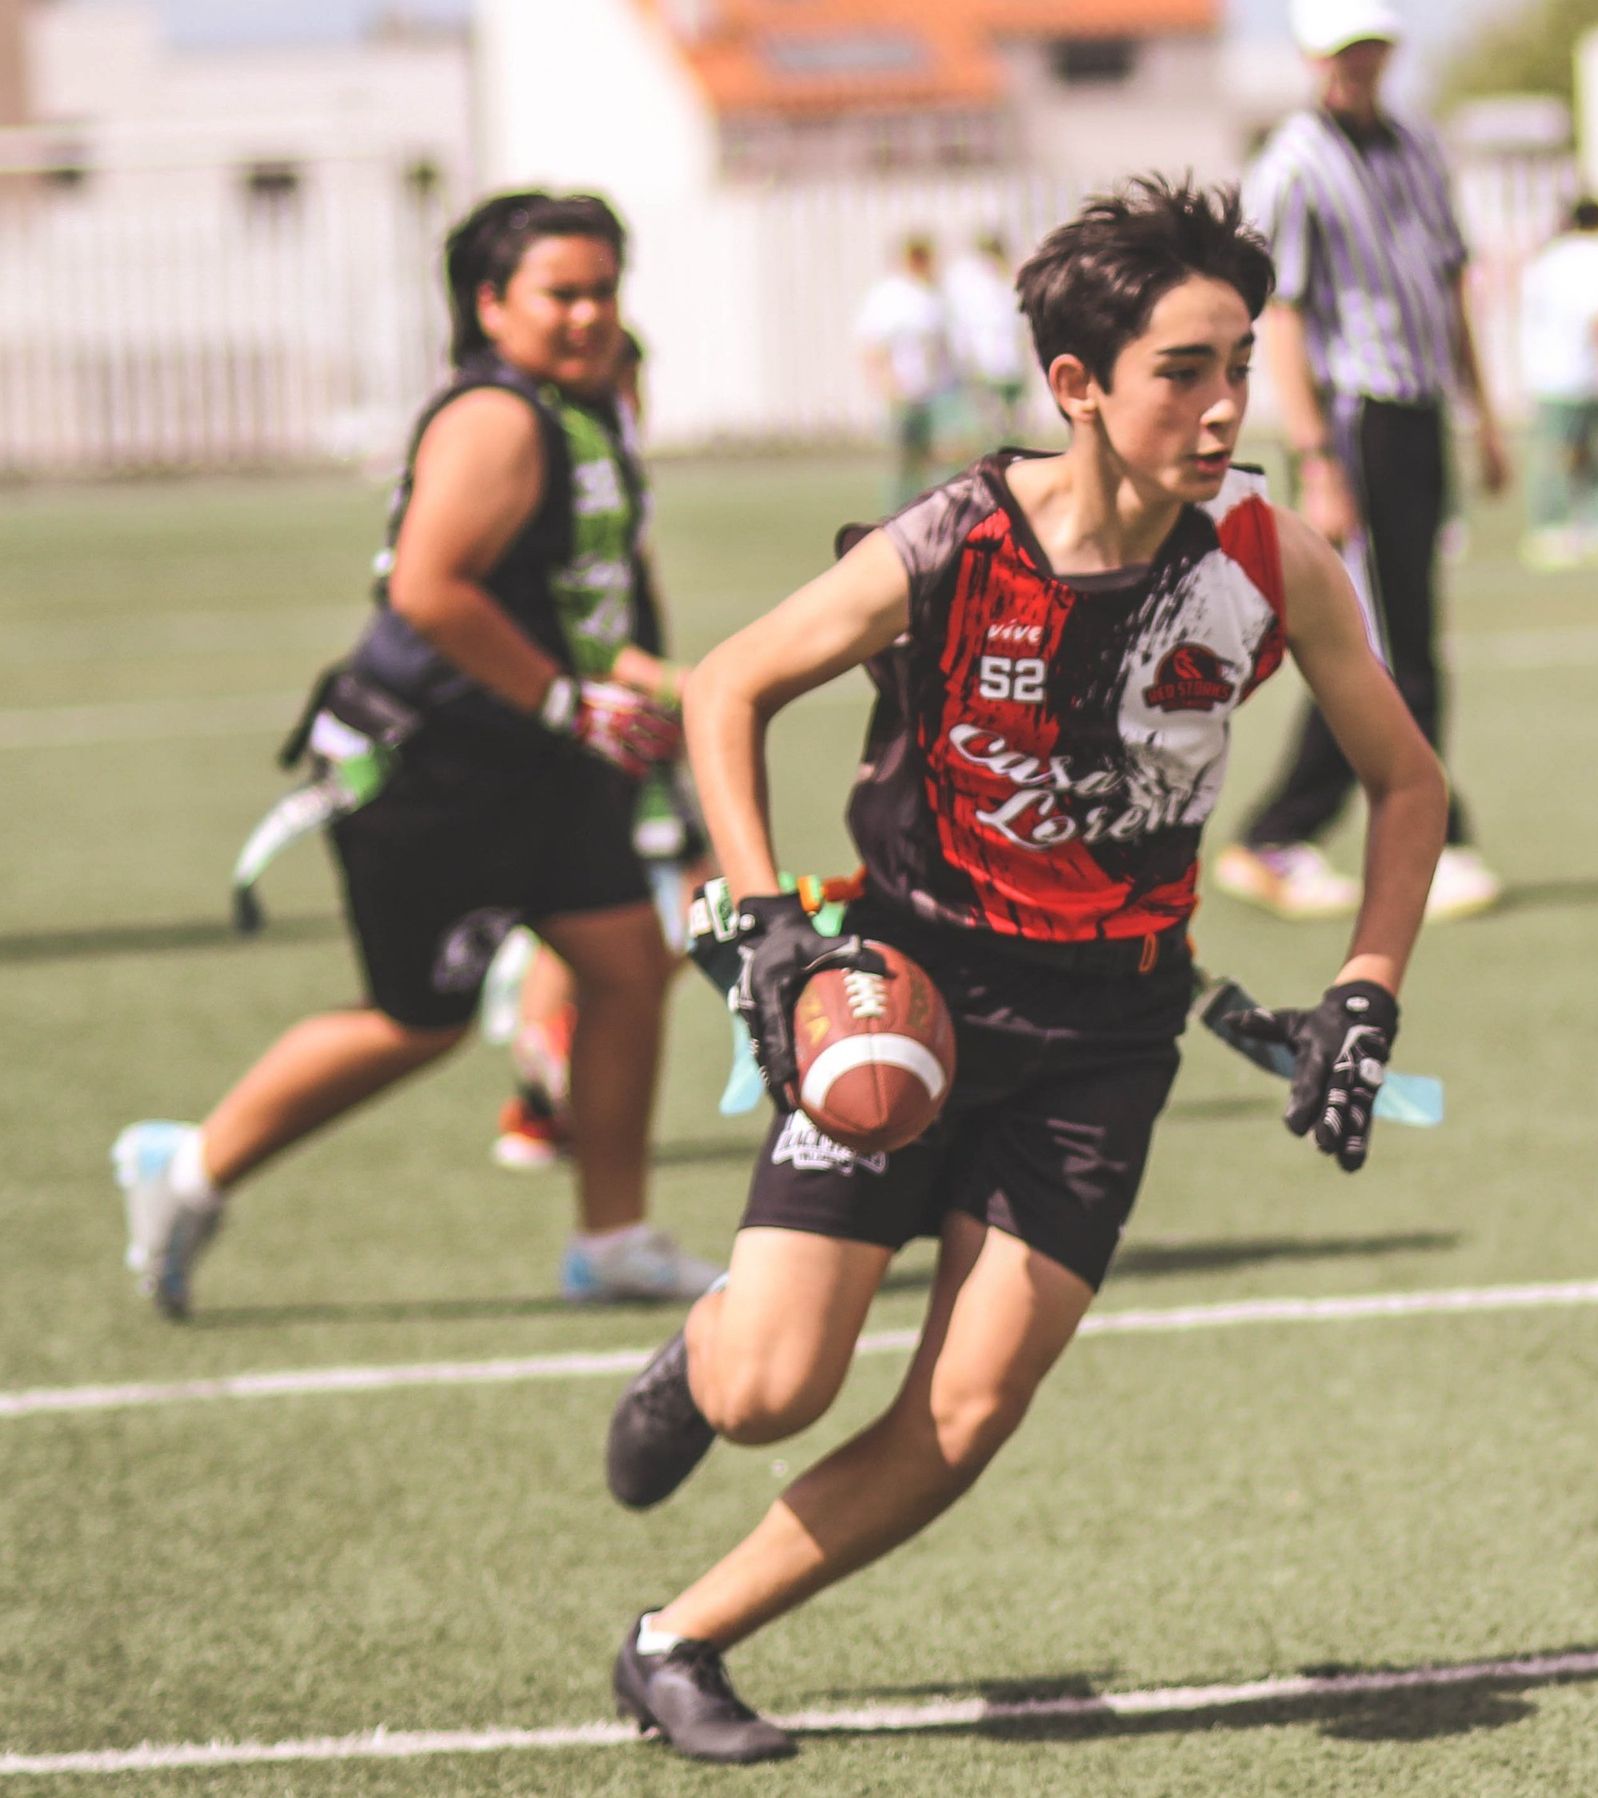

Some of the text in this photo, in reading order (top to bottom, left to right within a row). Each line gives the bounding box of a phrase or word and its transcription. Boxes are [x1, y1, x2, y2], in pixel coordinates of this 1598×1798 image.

[979, 655, 1045, 702] 52
[949, 723, 1126, 793] Casa
[975, 788, 1185, 850] Loren
